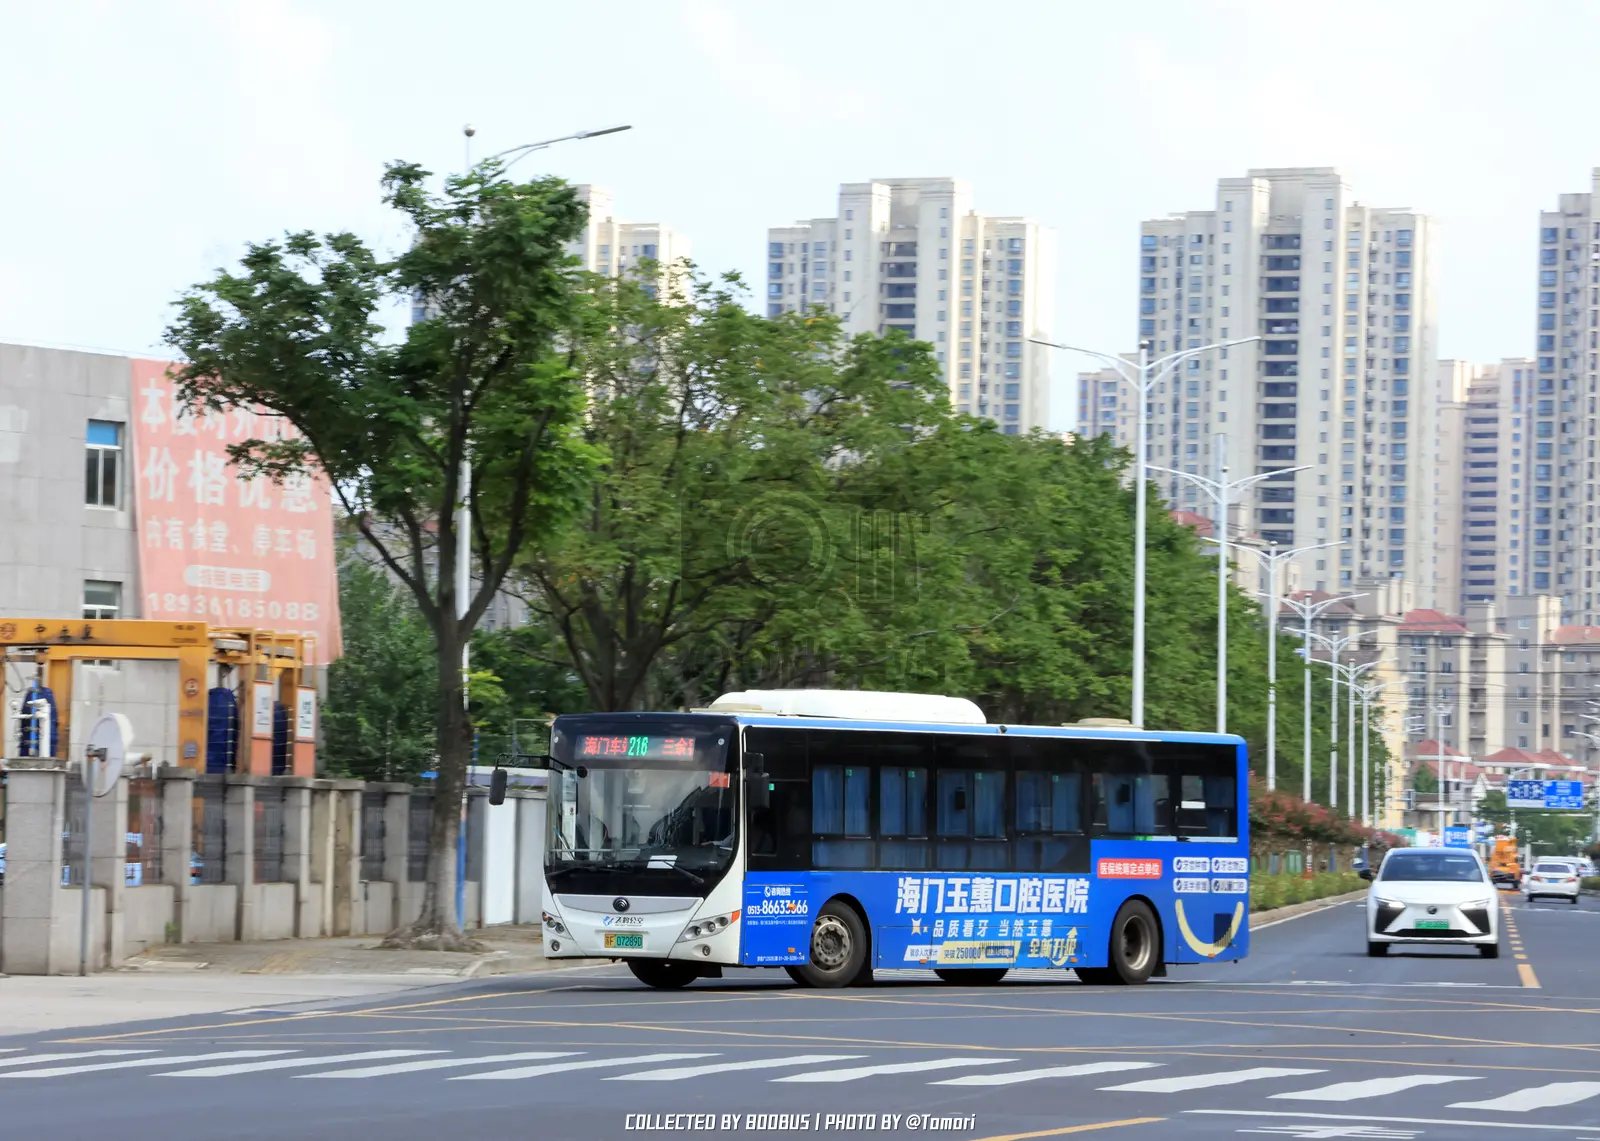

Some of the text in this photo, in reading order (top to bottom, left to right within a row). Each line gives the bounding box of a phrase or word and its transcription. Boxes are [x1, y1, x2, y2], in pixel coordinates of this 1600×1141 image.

[895, 876, 1090, 914] 海门玉蕙口腔医院
